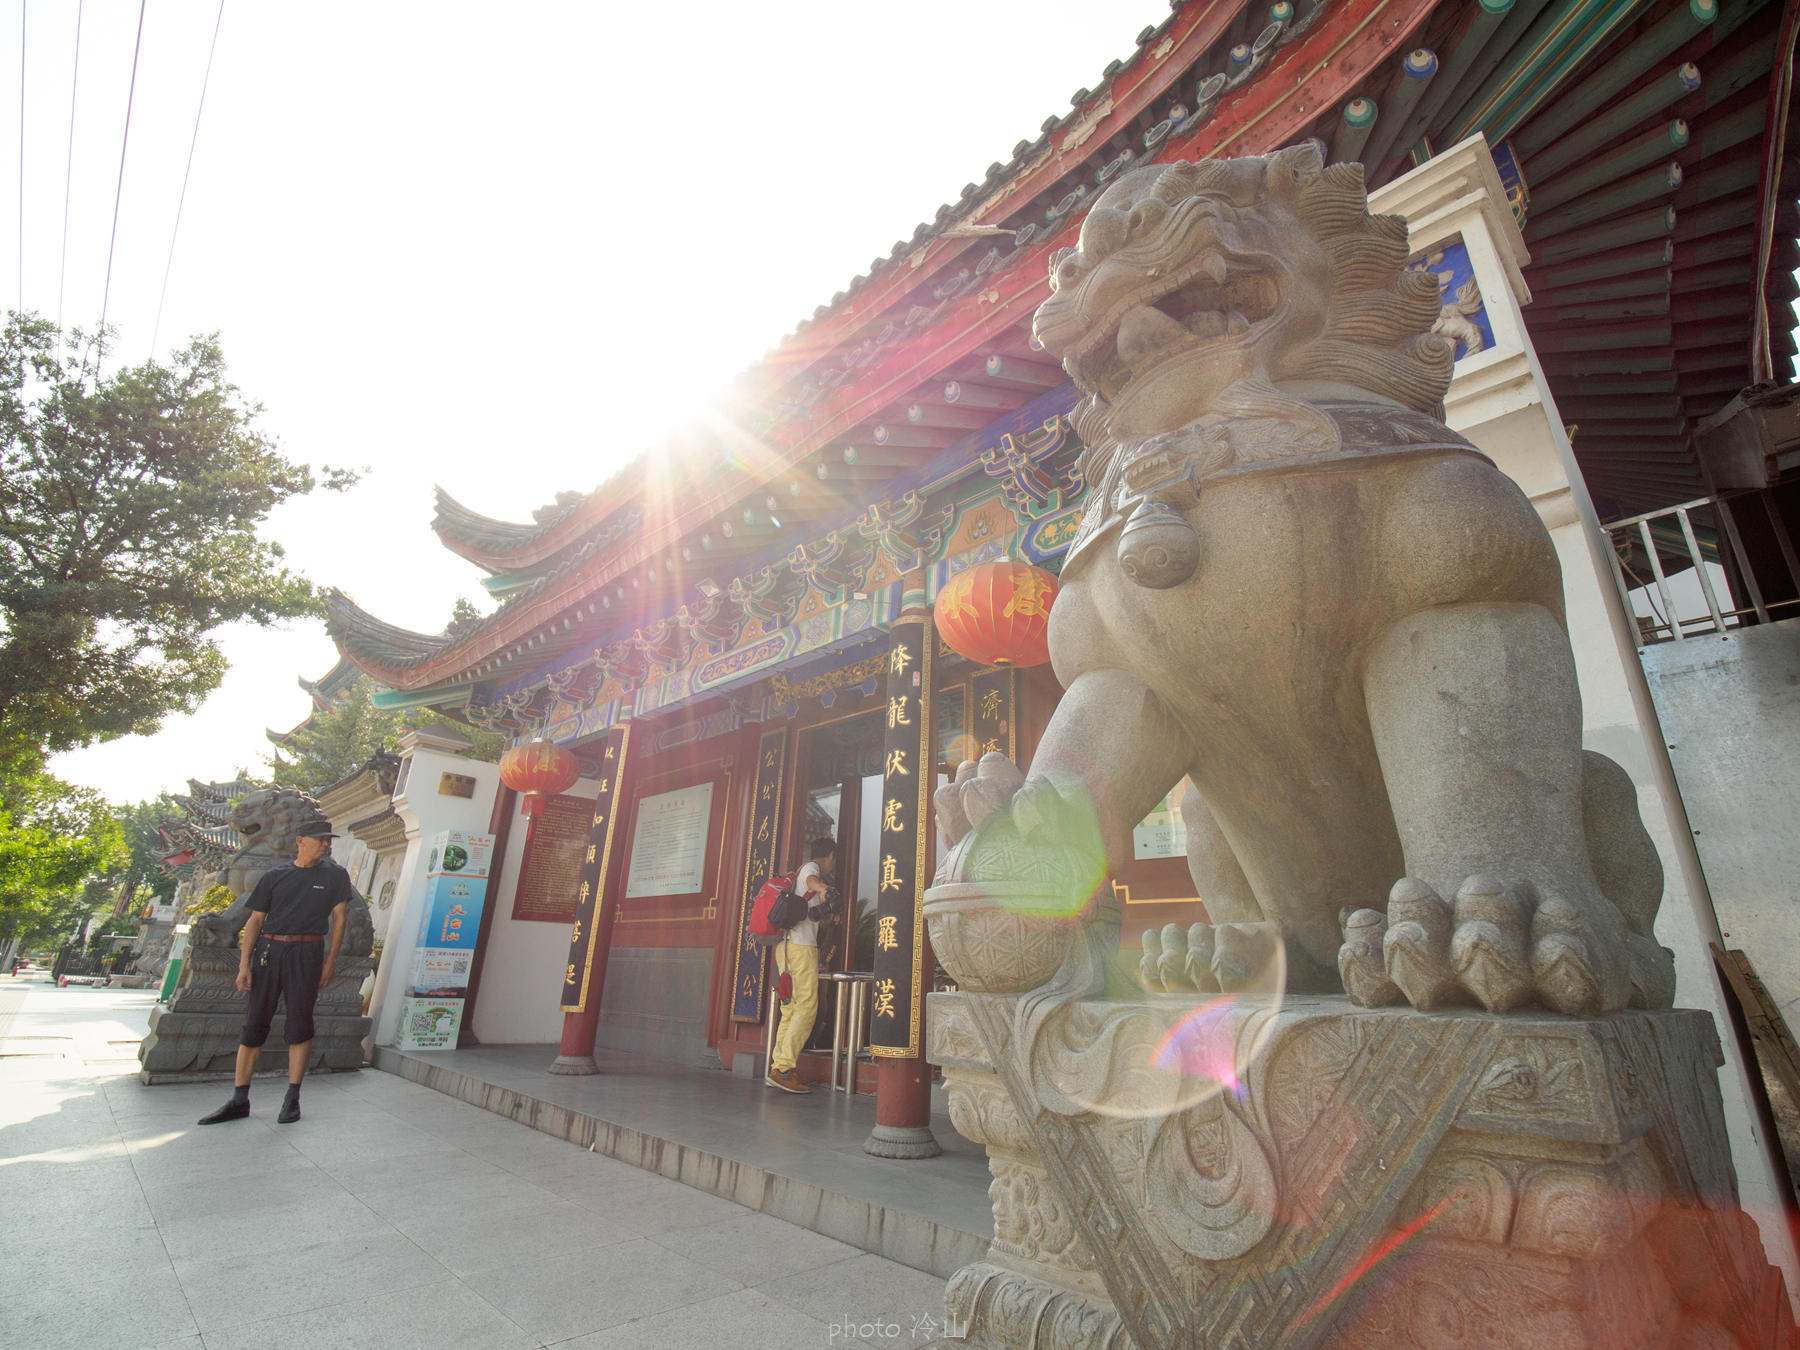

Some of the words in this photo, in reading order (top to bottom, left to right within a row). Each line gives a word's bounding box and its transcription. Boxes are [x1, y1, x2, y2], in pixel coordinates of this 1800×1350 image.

[873, 641, 913, 1019] 降龍伏虎真羅漢
